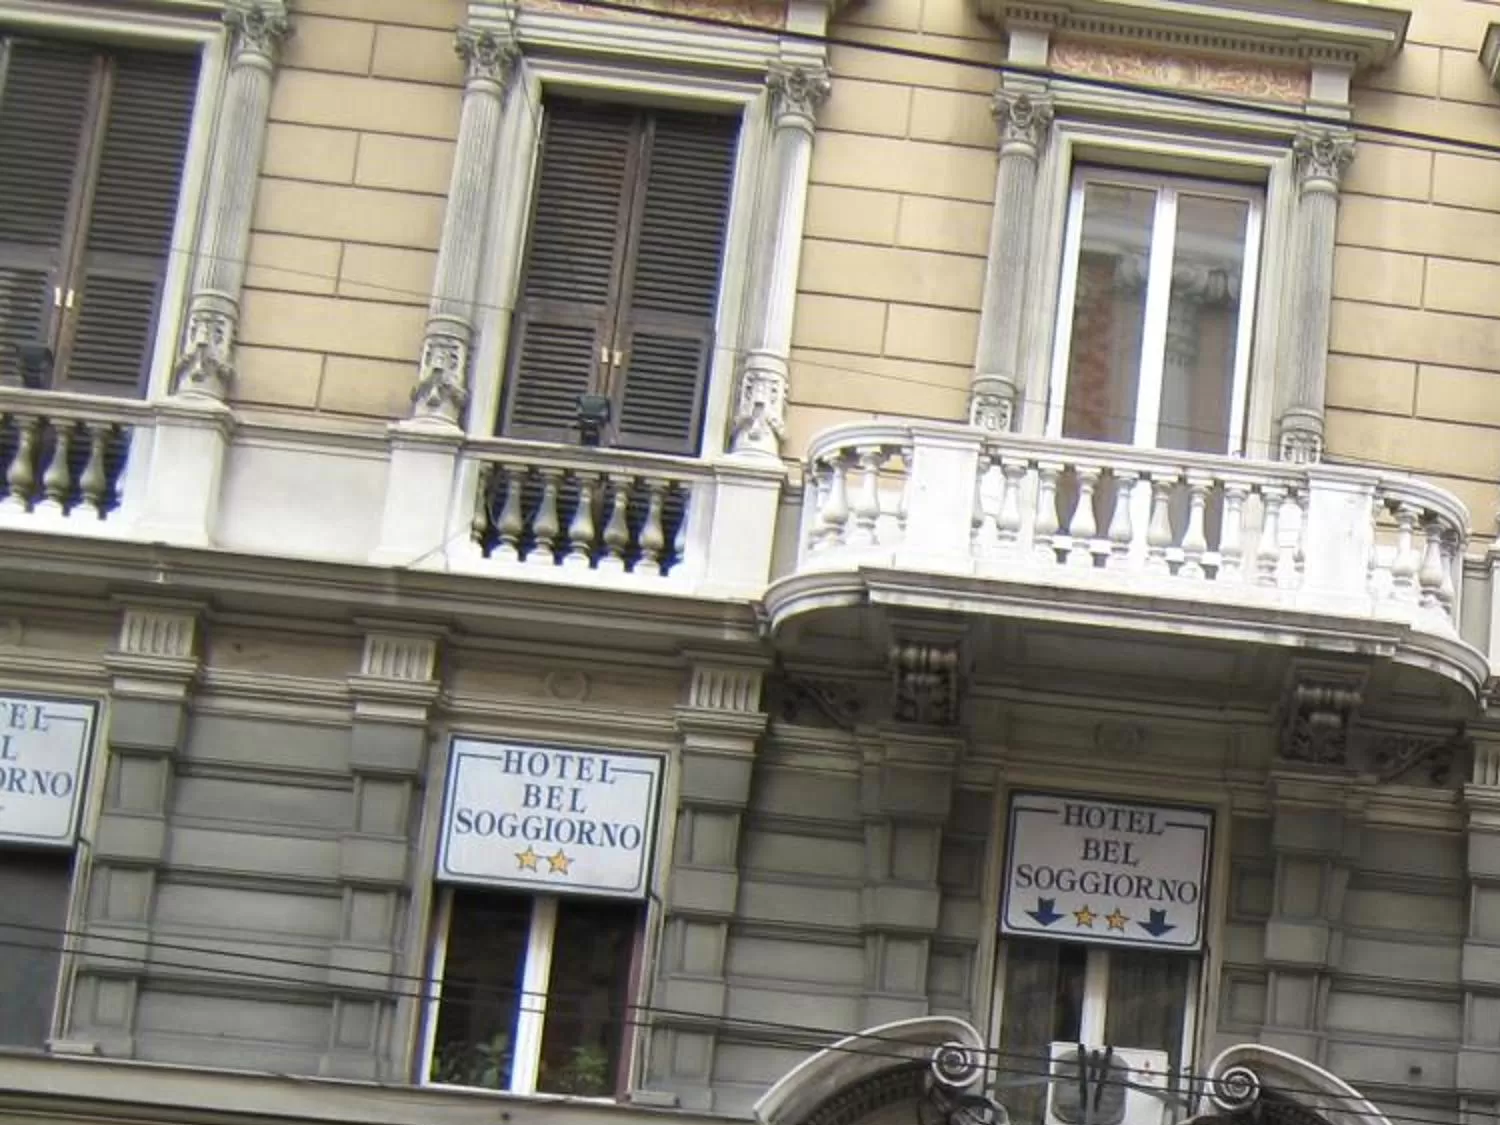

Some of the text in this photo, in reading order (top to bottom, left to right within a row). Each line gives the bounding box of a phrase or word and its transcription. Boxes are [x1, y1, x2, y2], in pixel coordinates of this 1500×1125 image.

[502, 749, 616, 784] HOTEL
[521, 783, 588, 814] BEL
[455, 808, 641, 850] SOGGIORNO
[1062, 802, 1165, 836] HOTEL
[1081, 838, 1140, 867] BEL
[1015, 863, 1198, 904] SOGGIORNO
